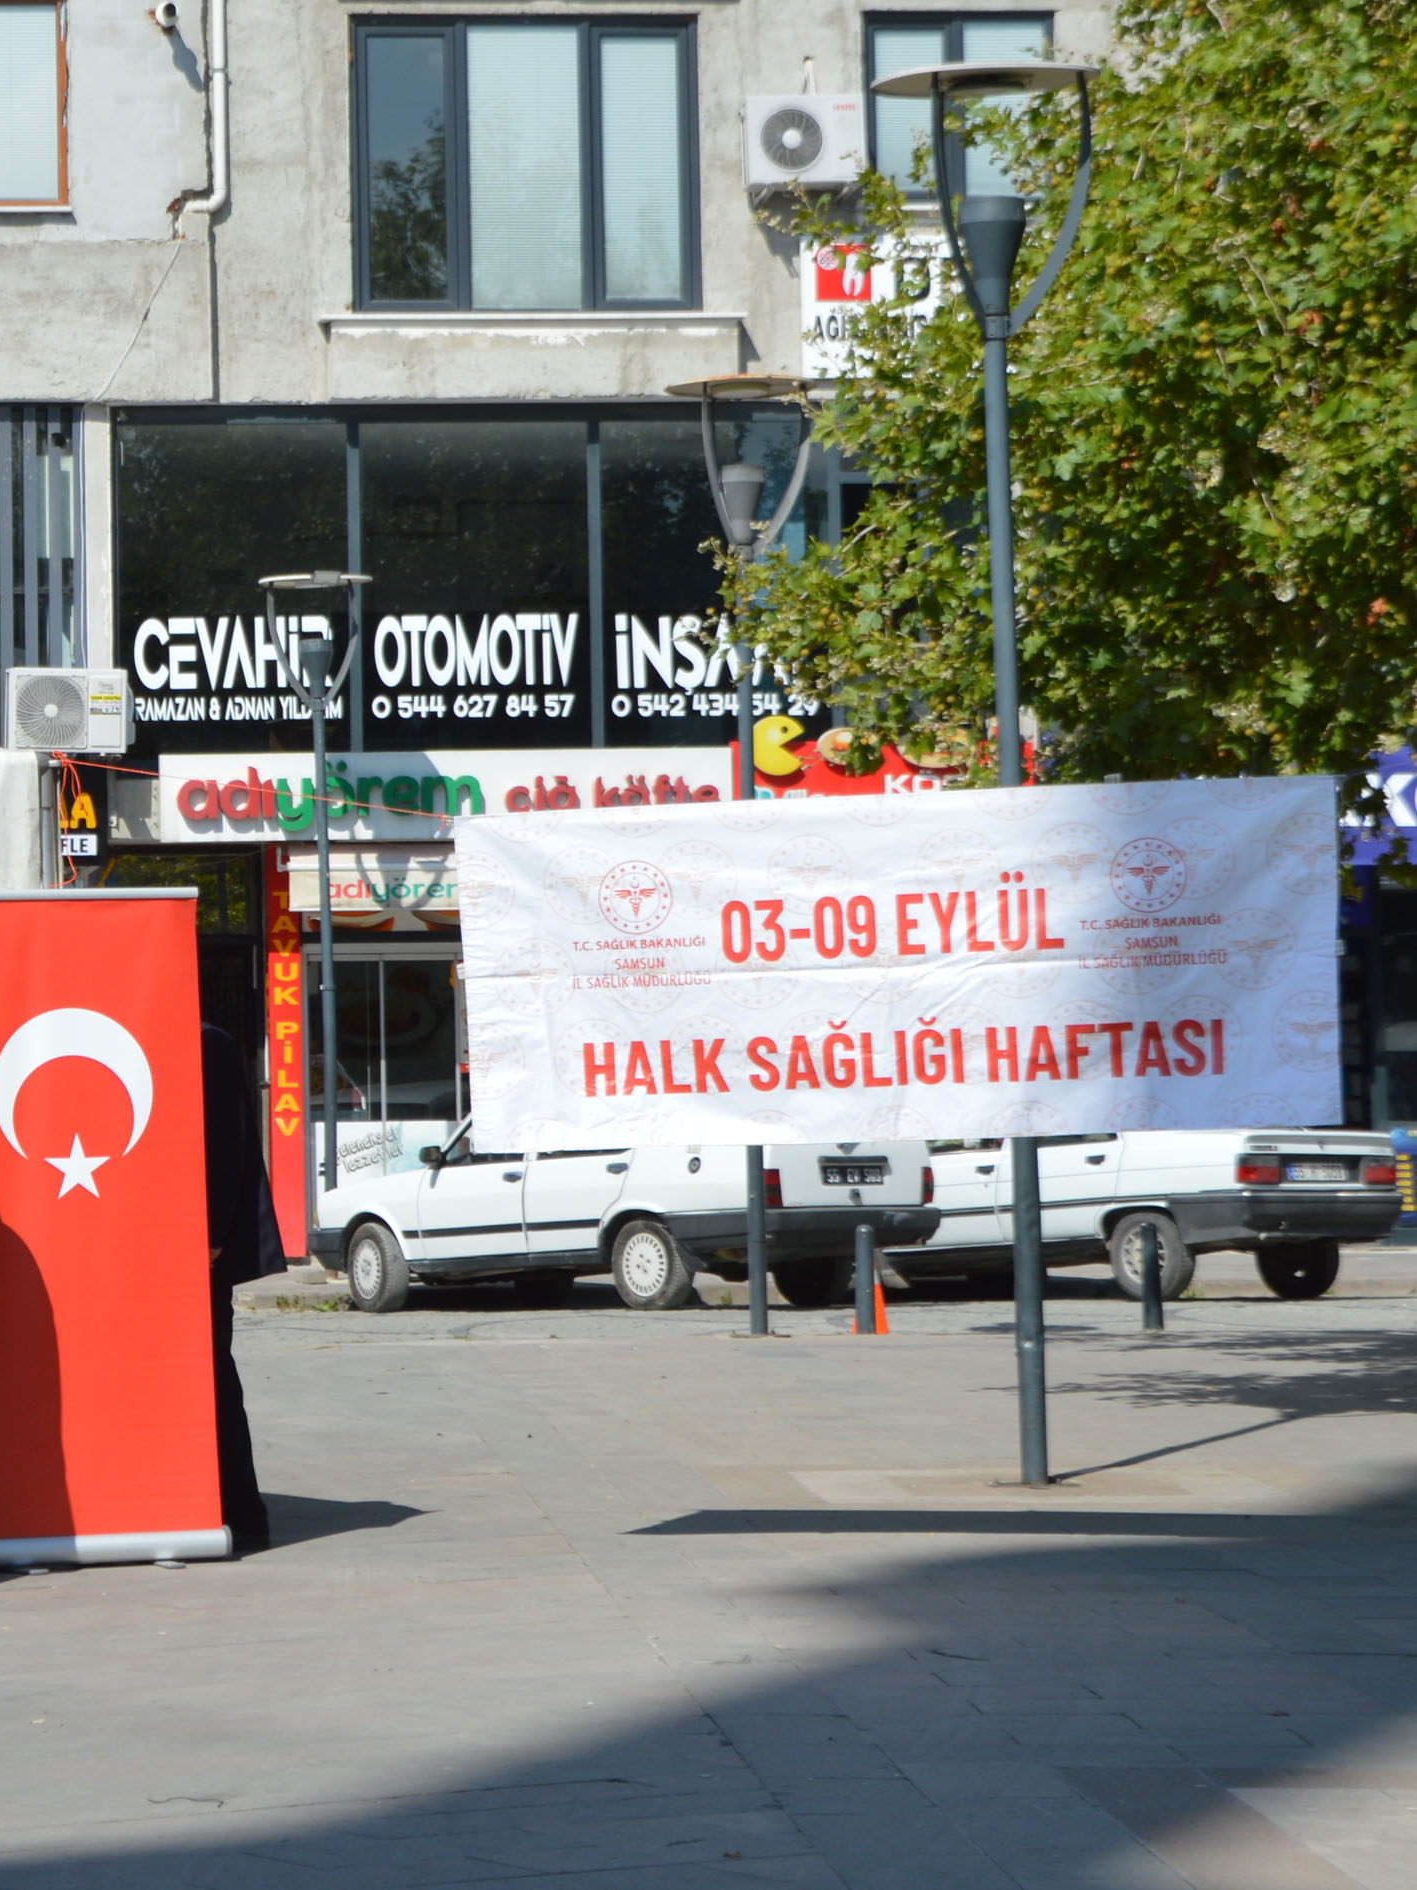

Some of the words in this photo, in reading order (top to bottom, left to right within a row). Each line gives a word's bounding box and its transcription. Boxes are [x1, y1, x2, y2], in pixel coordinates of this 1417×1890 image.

[374, 613, 579, 687] OTOMOTİV
[135, 695, 205, 721] RAMAZAN
[209, 696, 221, 720] &
[225, 695, 275, 721] ADNAN
[397, 694, 446, 719] 544
[453, 694, 499, 718] 627
[505, 694, 538, 718] 84
[544, 694, 576, 718] 57
[637, 693, 686, 717] 542
[692, 693, 739, 717] 434
[752, 693, 781, 716] 54
[721, 893, 877, 964] 03-09
[897, 871, 1065, 956] EYLÜL
[1079, 919, 1101, 930] T.C.
[1104, 915, 1150, 930] SAĞLIK
[1153, 912, 1222, 927] BAKANLIĞI
[573, 941, 593, 951] T.C.
[596, 938, 637, 950] SAĞLIK
[640, 935, 705, 949] BAKANLIĞI
[1125, 935, 1179, 950] SAMSUN
[614, 957, 665, 970] SAMSUN
[1094, 952, 1139, 969] SAĞLIK
[1142, 949, 1228, 967] MÜDÜRLÜĞÜ
[587, 974, 629, 989] SAĞLIK
[632, 970, 711, 988] MÜDÜRLÜĞÜ
[584, 1036, 729, 1097] HALK
[748, 1017, 965, 1091] SAĞLIĞI
[986, 1018, 1223, 1083] HAFTASI
[274, 1022, 301, 1137] PİLAV
